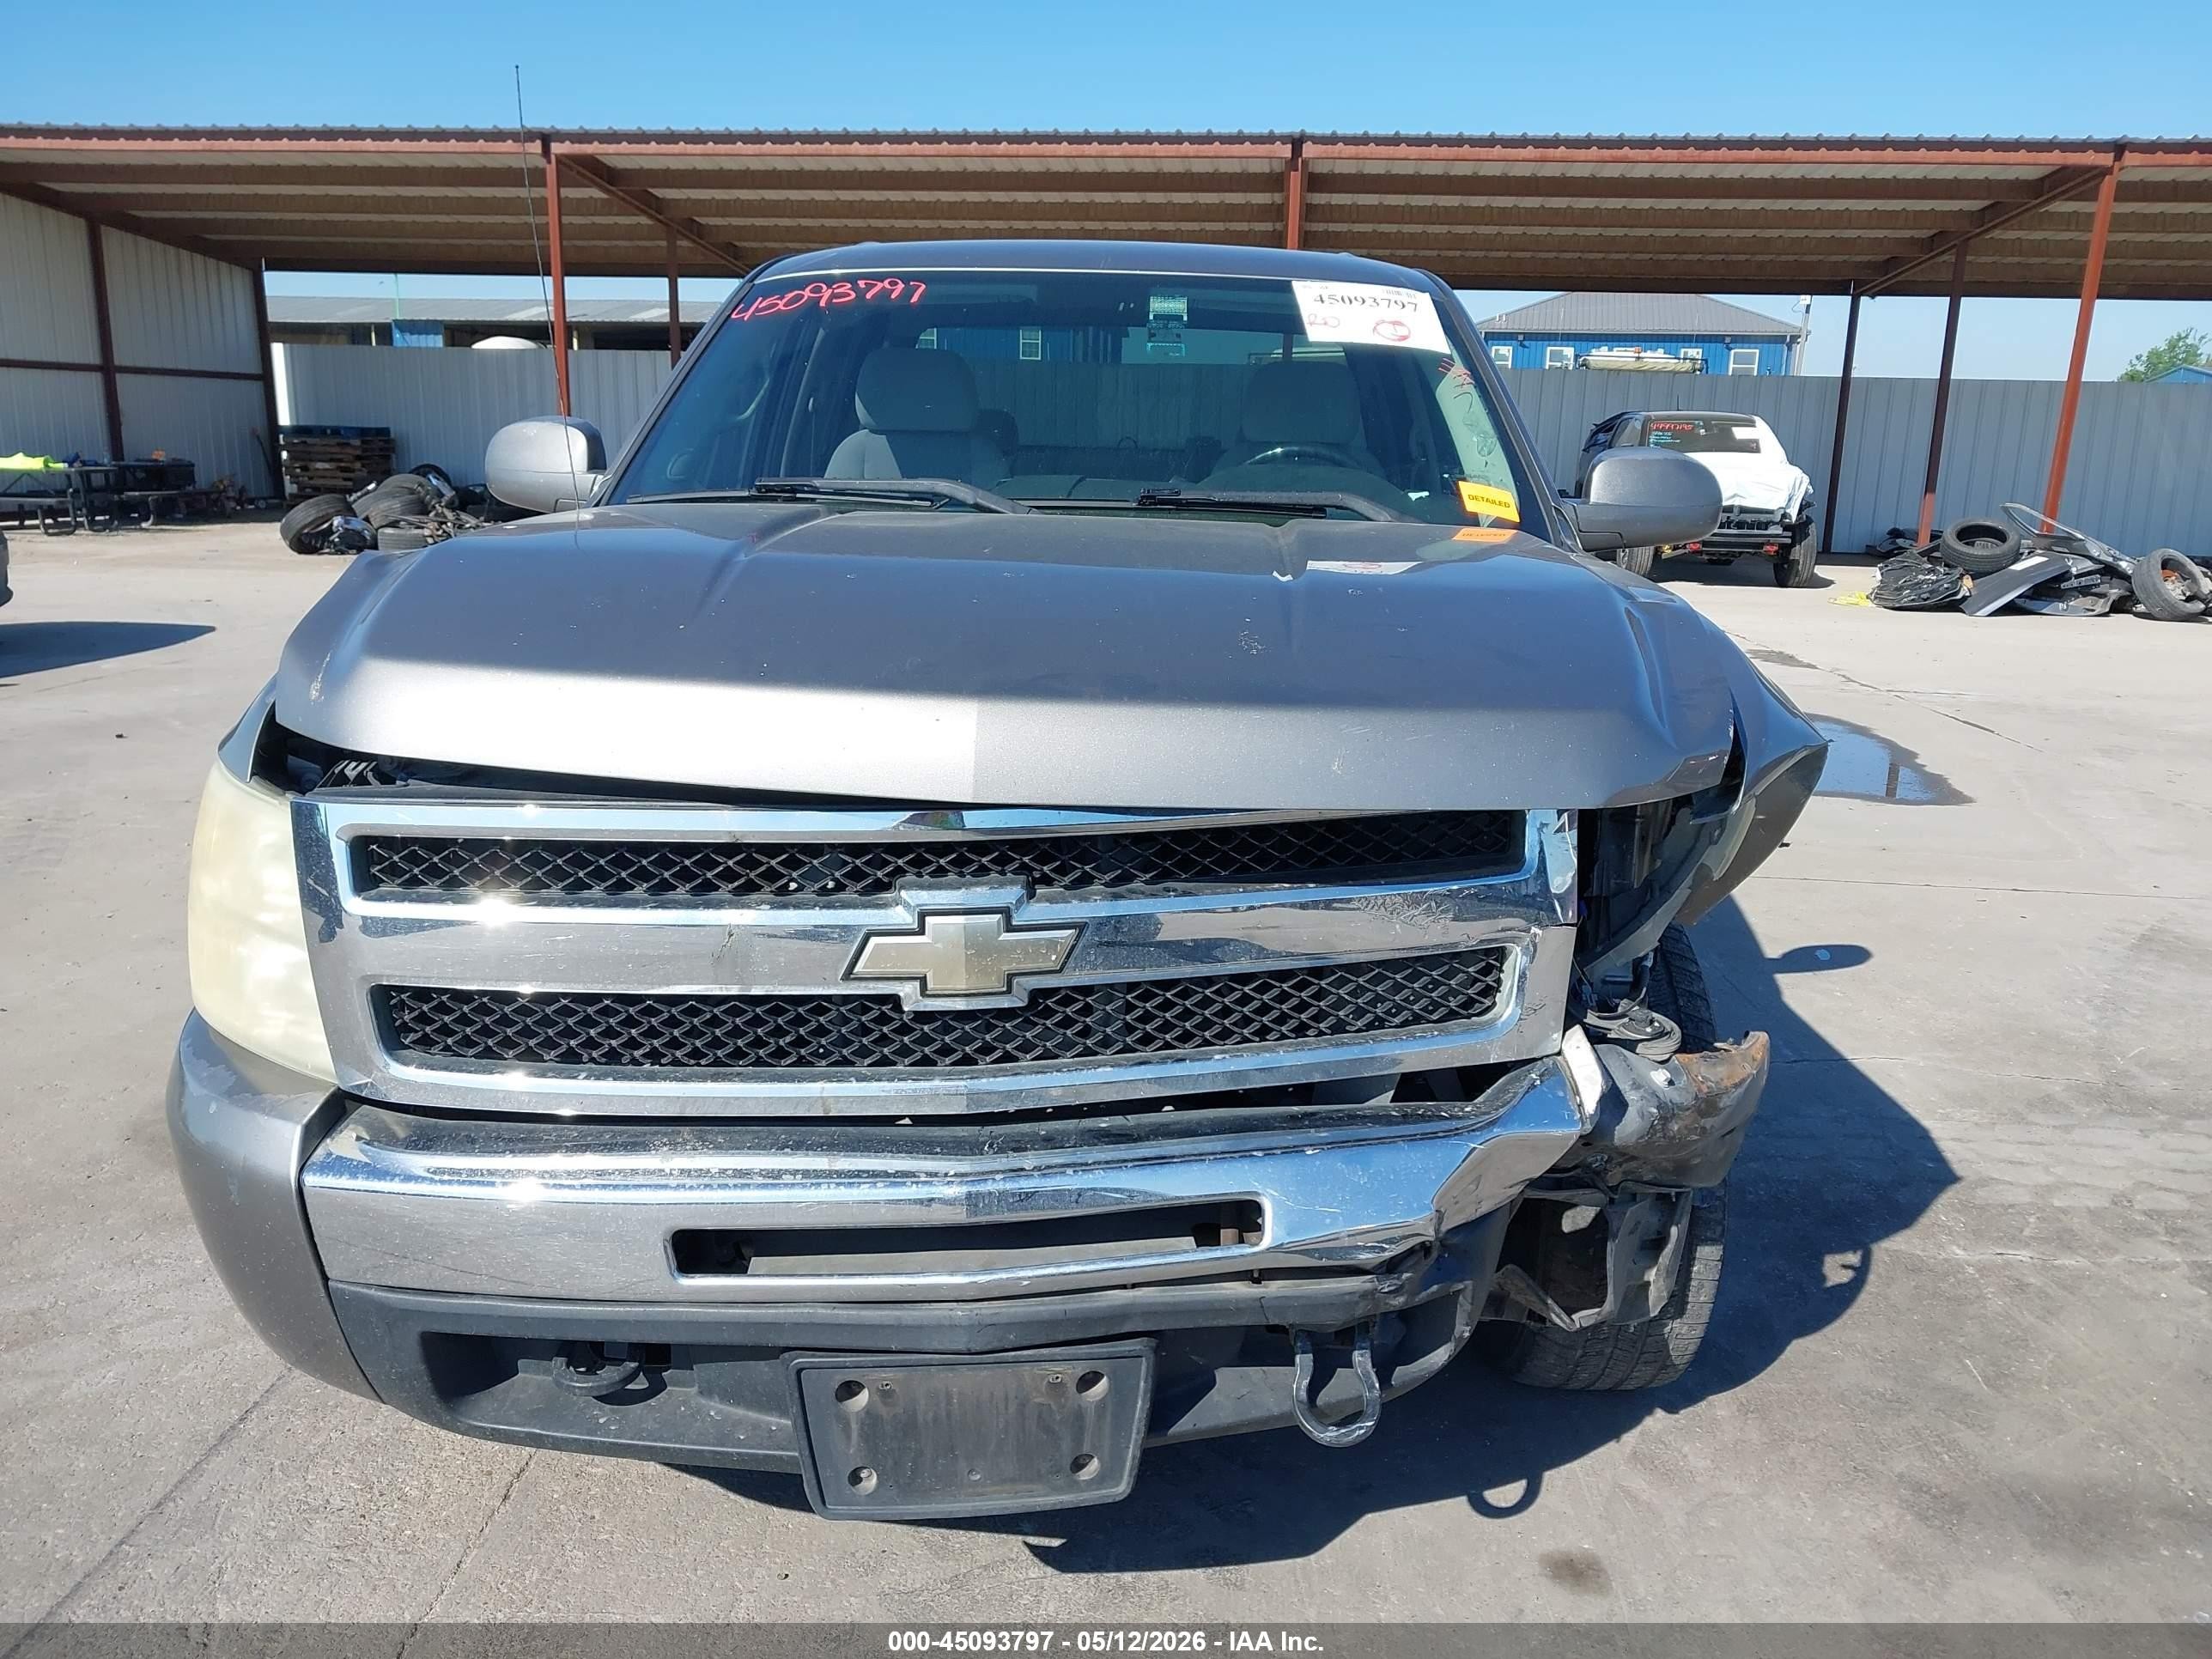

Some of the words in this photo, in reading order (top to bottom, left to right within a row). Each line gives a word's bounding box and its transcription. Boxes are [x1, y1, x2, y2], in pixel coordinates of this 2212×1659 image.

[731, 277, 927, 321] 45093797
[1313, 293, 1419, 313] 45093797
[1468, 494, 1510, 508] DETAILED
